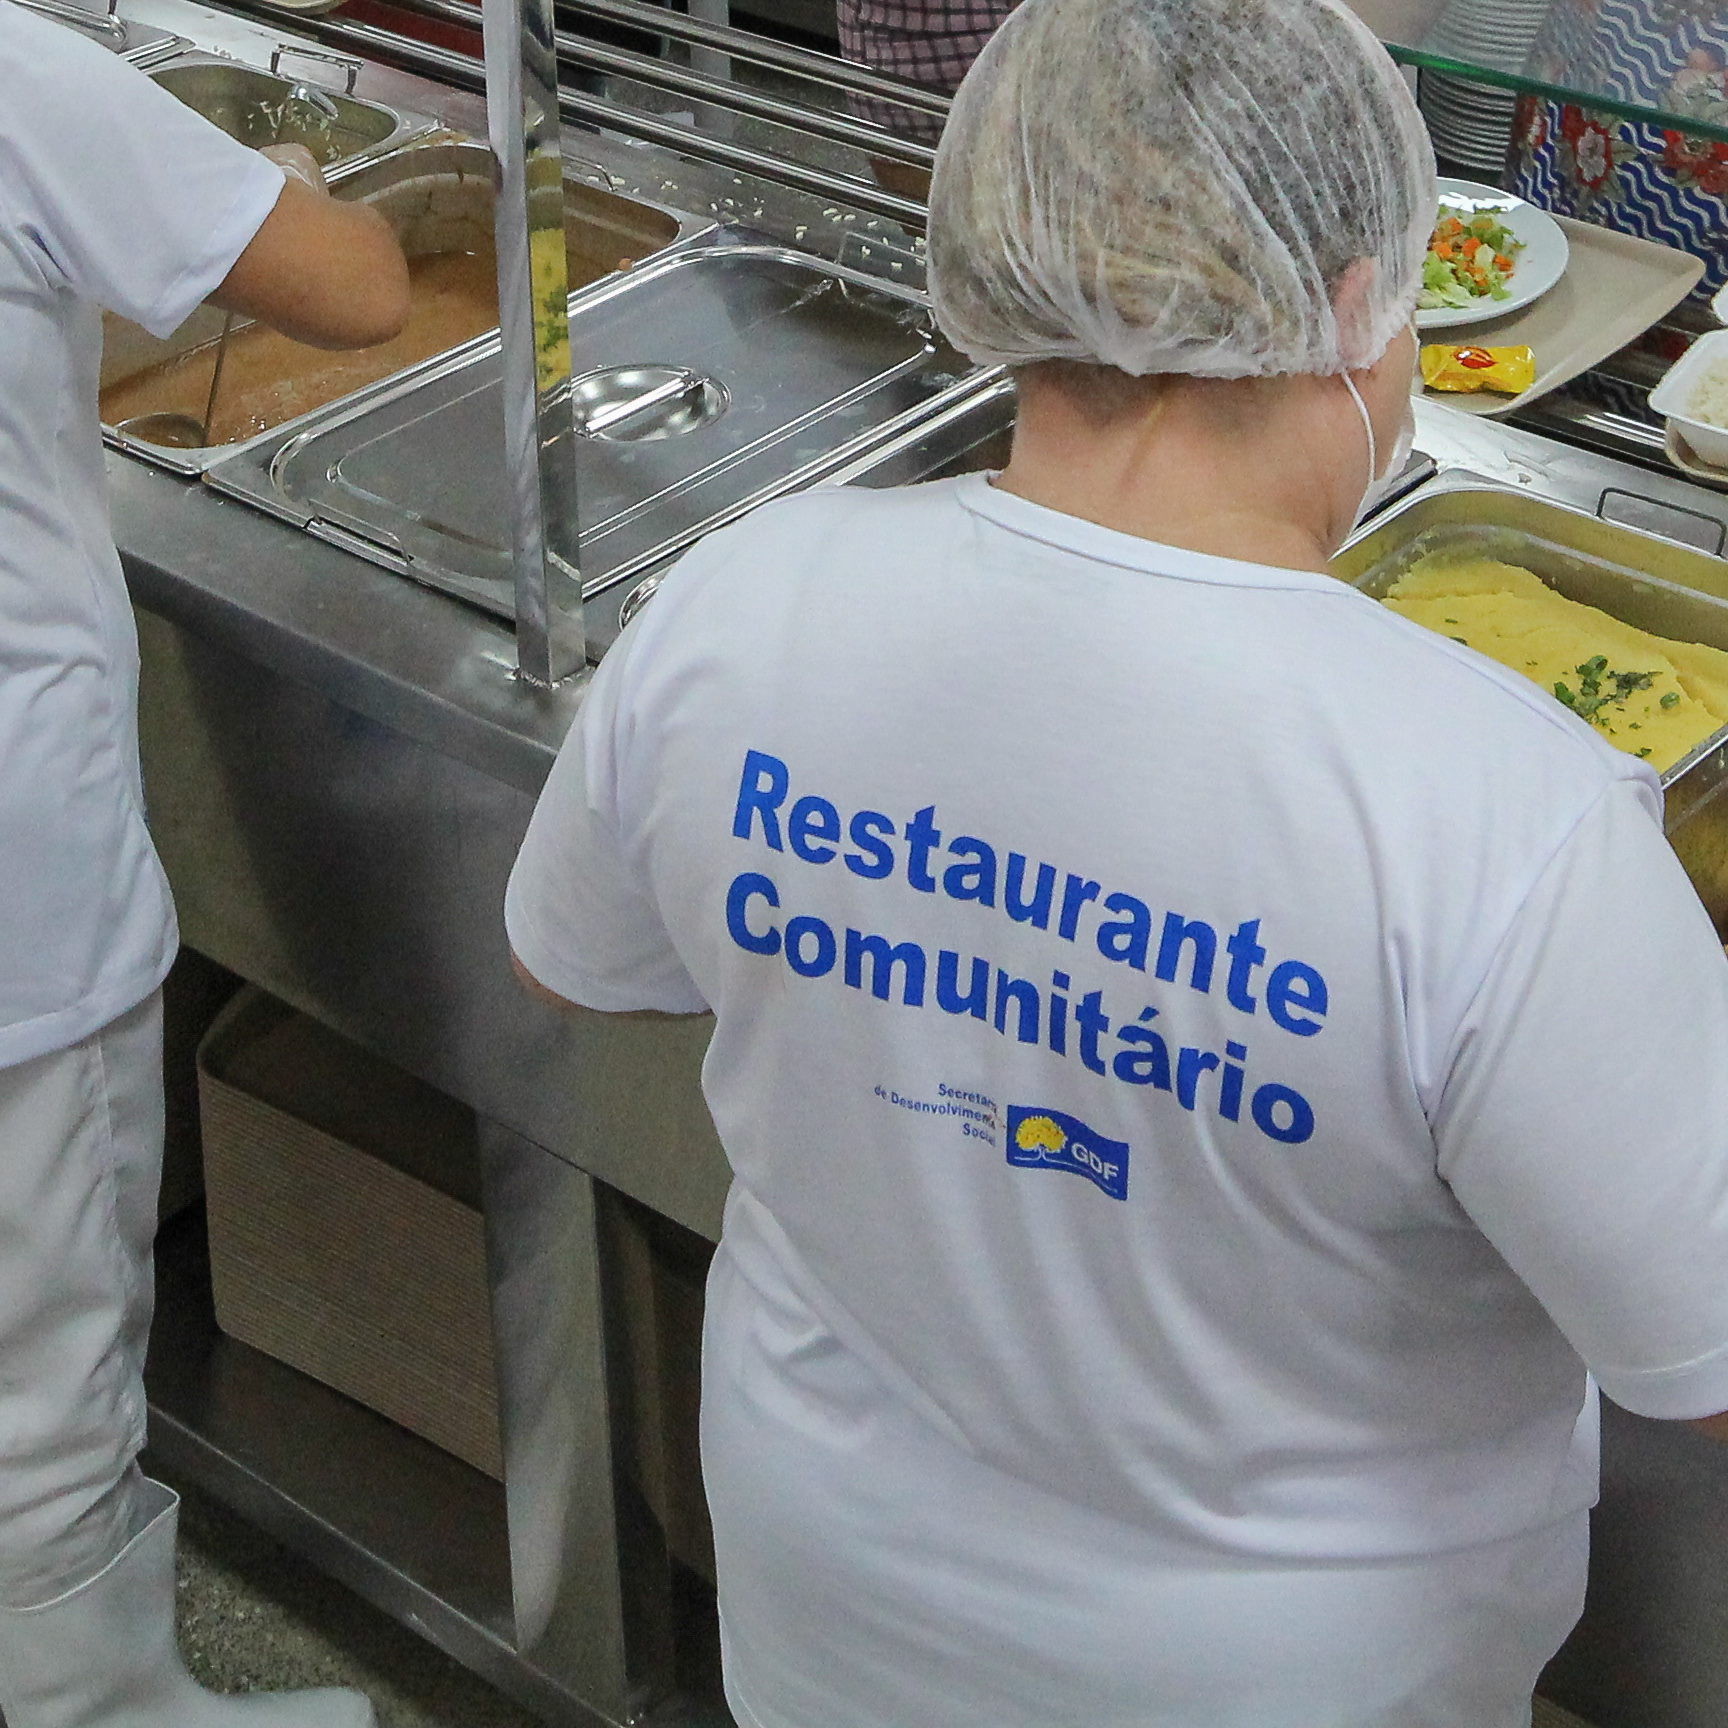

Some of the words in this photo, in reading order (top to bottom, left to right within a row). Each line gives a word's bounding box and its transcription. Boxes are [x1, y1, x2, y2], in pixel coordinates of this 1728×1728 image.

[732, 748, 1330, 1039] Restaurante
[726, 871, 1315, 1145] Comunitário
[874, 1085, 888, 1100] de
[1071, 1142, 1119, 1181] GDF
